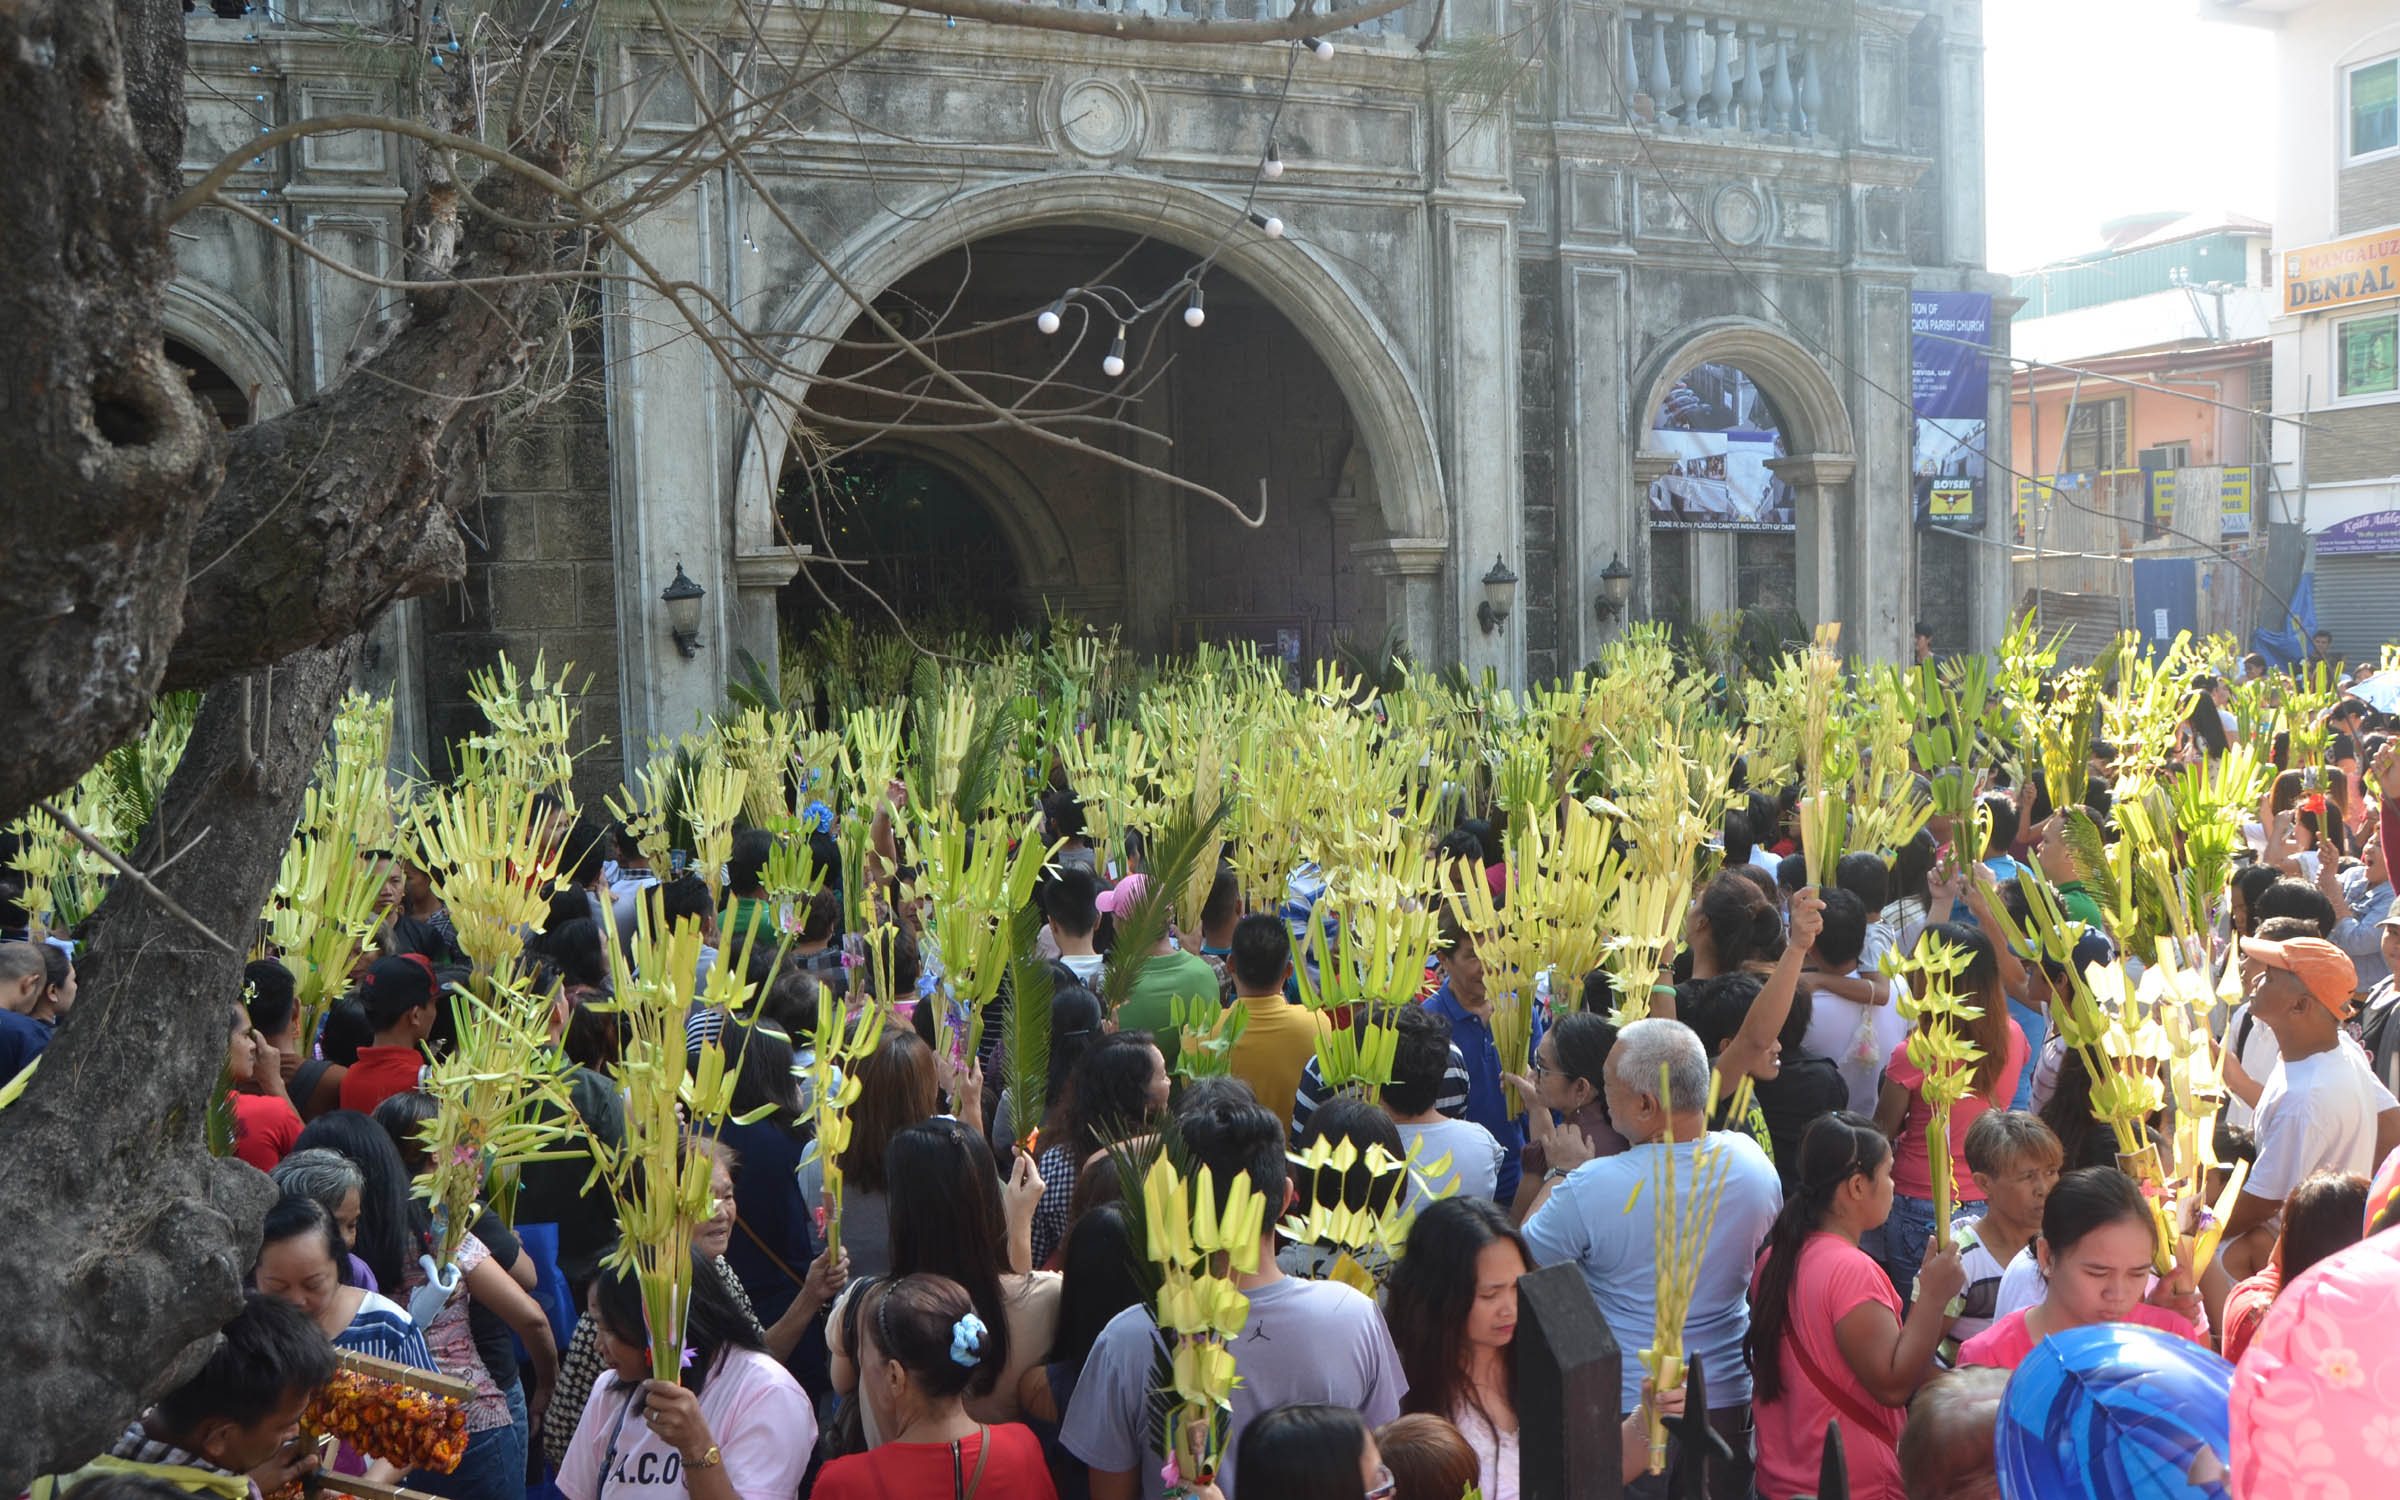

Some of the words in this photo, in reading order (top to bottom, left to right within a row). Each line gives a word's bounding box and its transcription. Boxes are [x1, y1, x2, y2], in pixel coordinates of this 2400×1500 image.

[2290, 265, 2395, 306] DENTAL
[1928, 303, 1938, 314] OF
[1930, 319, 1955, 331] PARISH
[1957, 320, 1984, 332] CHURCH
[1933, 480, 1971, 489] BOYSEN
